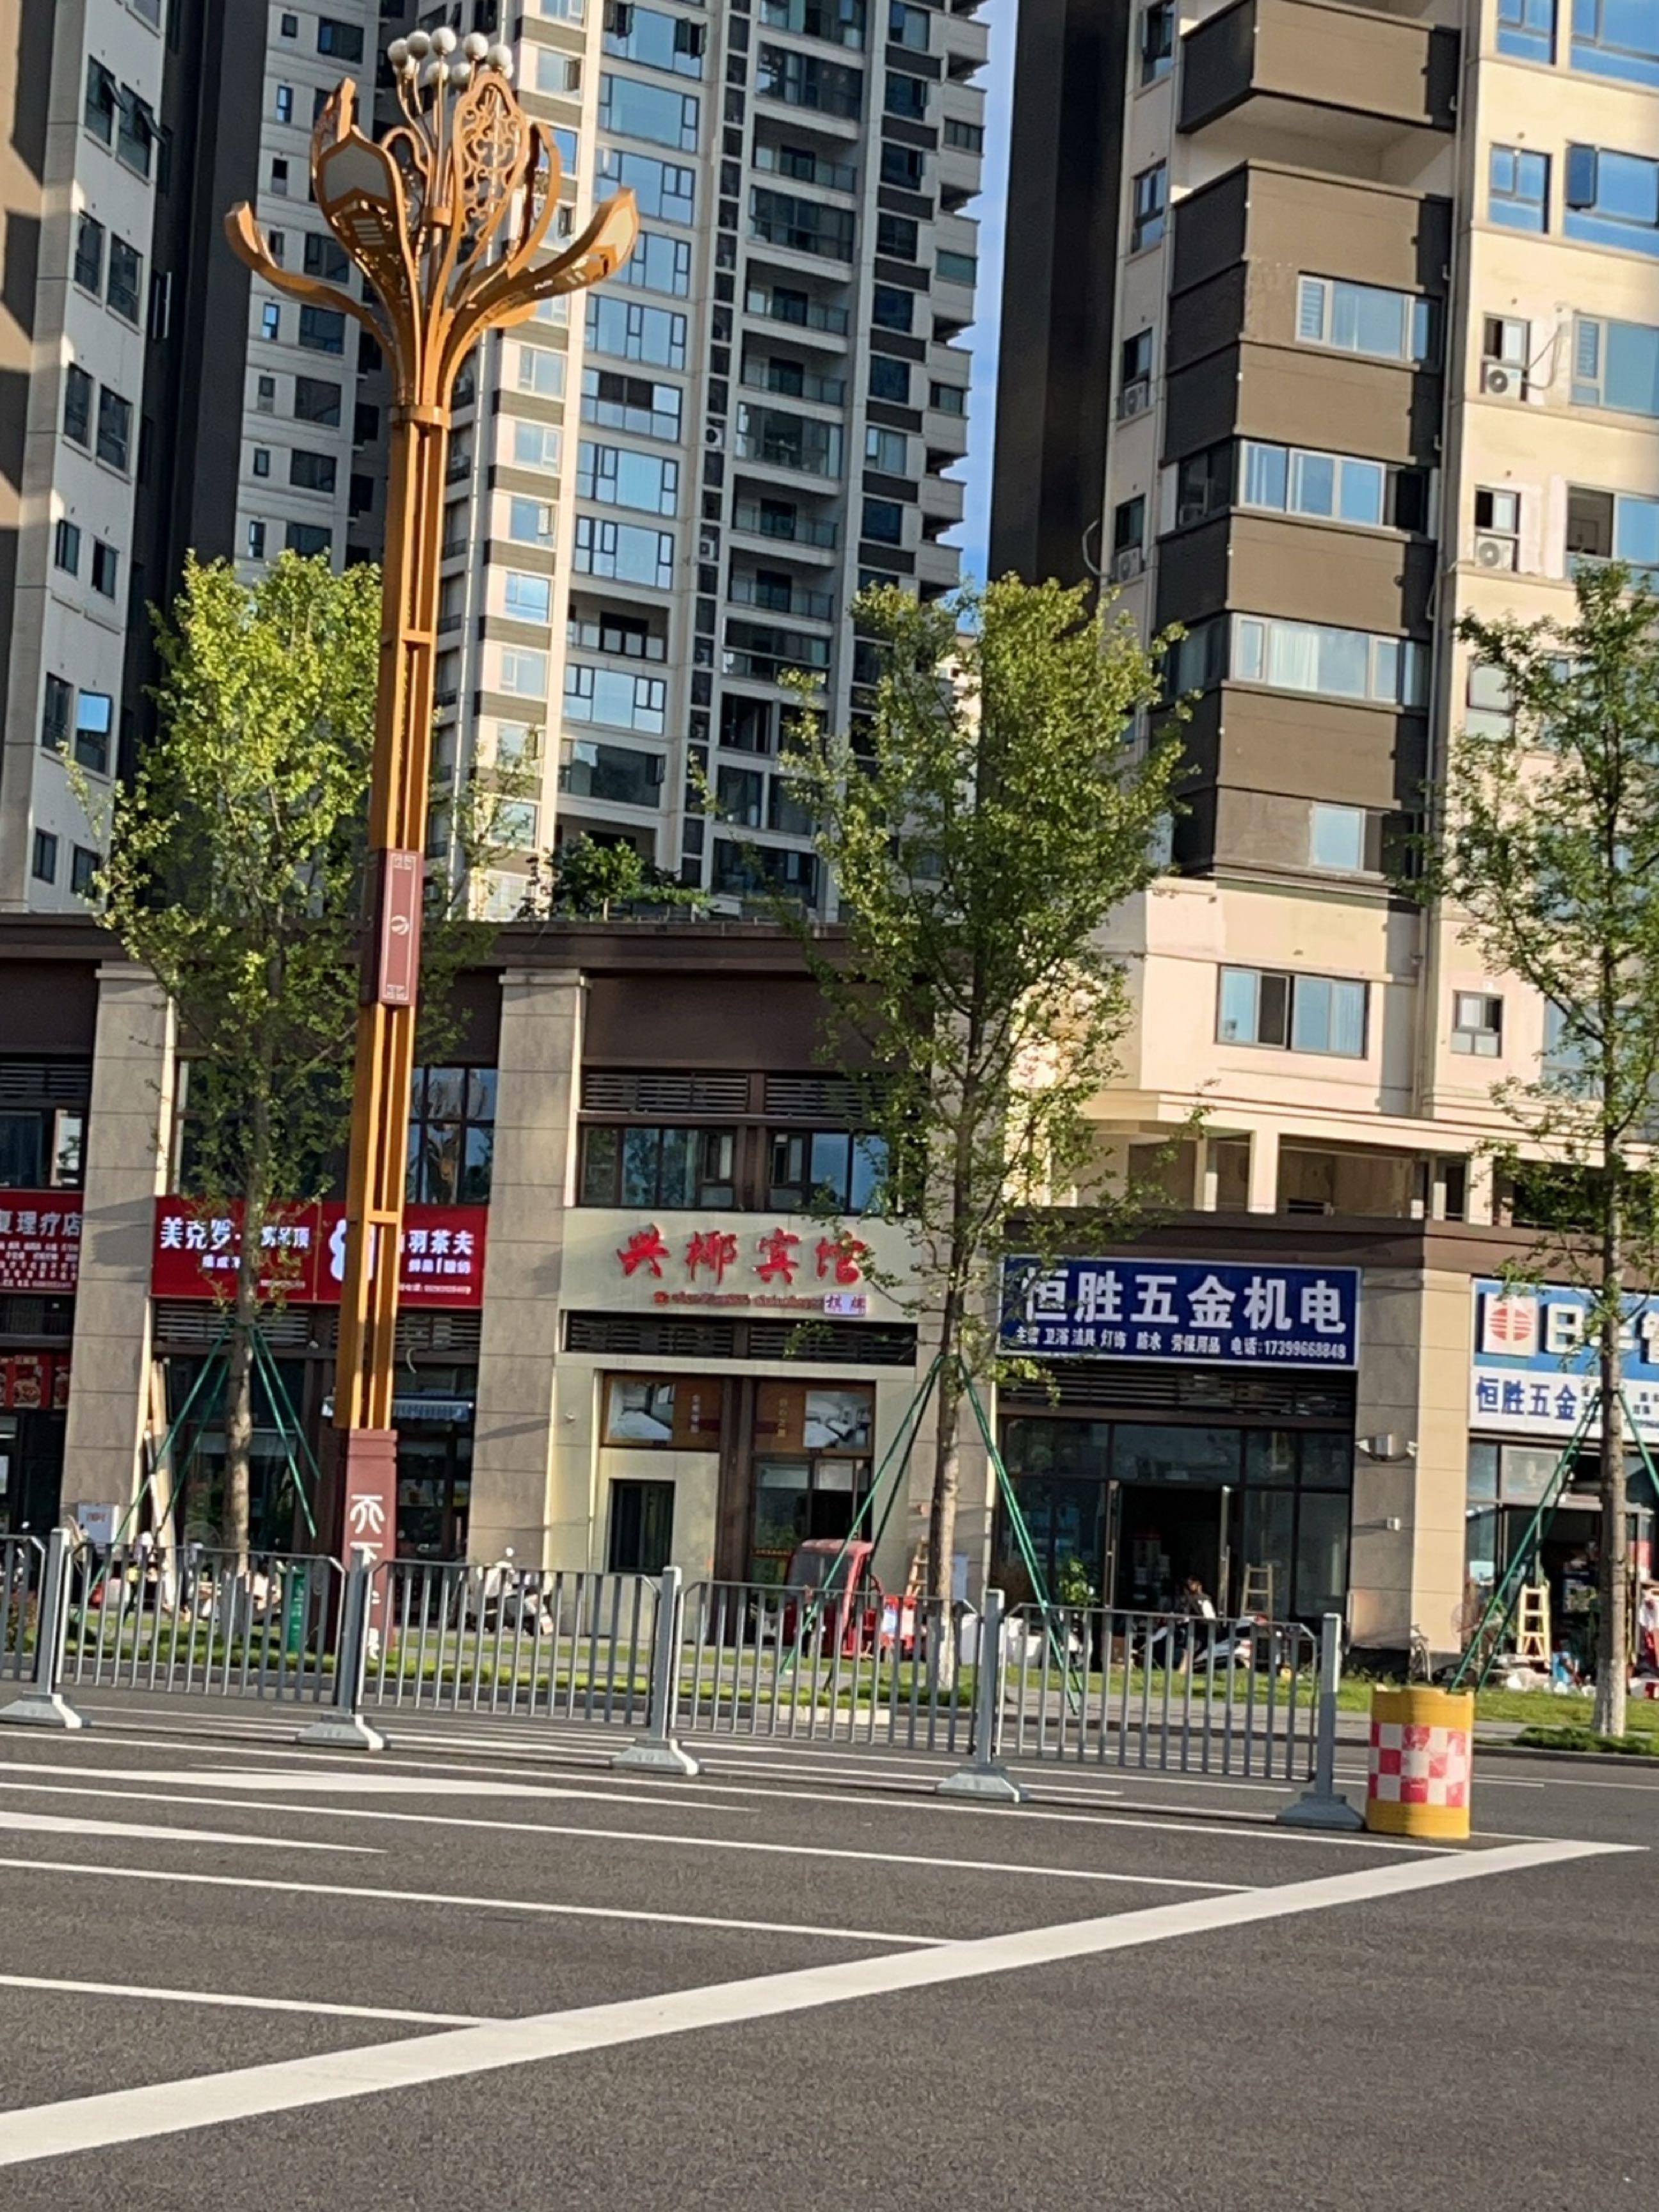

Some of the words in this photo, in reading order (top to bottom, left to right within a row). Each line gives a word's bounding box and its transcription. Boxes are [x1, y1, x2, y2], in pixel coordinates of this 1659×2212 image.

[1023, 1266, 1347, 1333] 恒胜五金机电
[1171, 1333, 1221, 1354] 劳保用品
[1476, 1376, 1577, 1420] 恒胜五金
